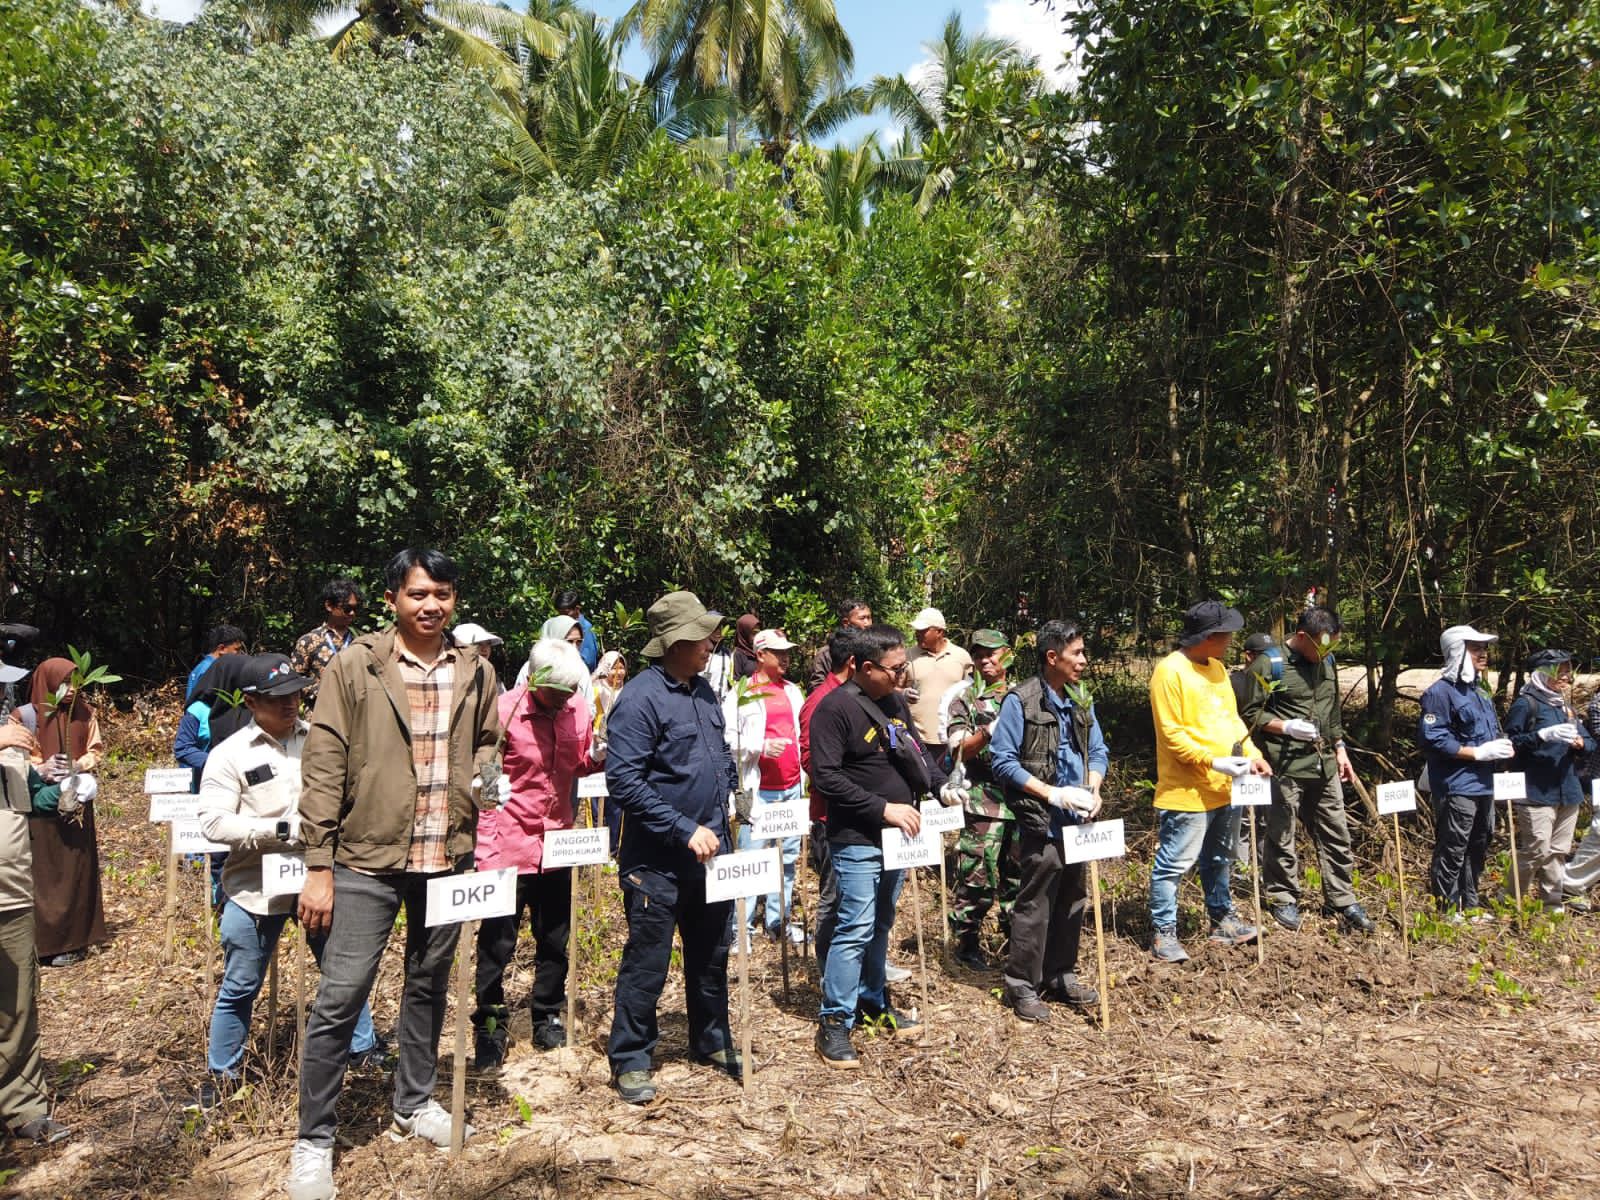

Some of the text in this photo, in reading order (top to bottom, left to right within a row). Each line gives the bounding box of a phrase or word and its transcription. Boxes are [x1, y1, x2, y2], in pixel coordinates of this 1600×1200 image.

[764, 808, 793, 820] DPRD
[761, 821, 799, 833] KUKAR
[926, 816, 960, 826] TANJUNG
[554, 835, 601, 846] ANGGOTA
[1075, 830, 1113, 846] CAMAT
[896, 848, 929, 861] KUKAR
[717, 860, 771, 881] DISHUT
[452, 884, 496, 907] DKP
